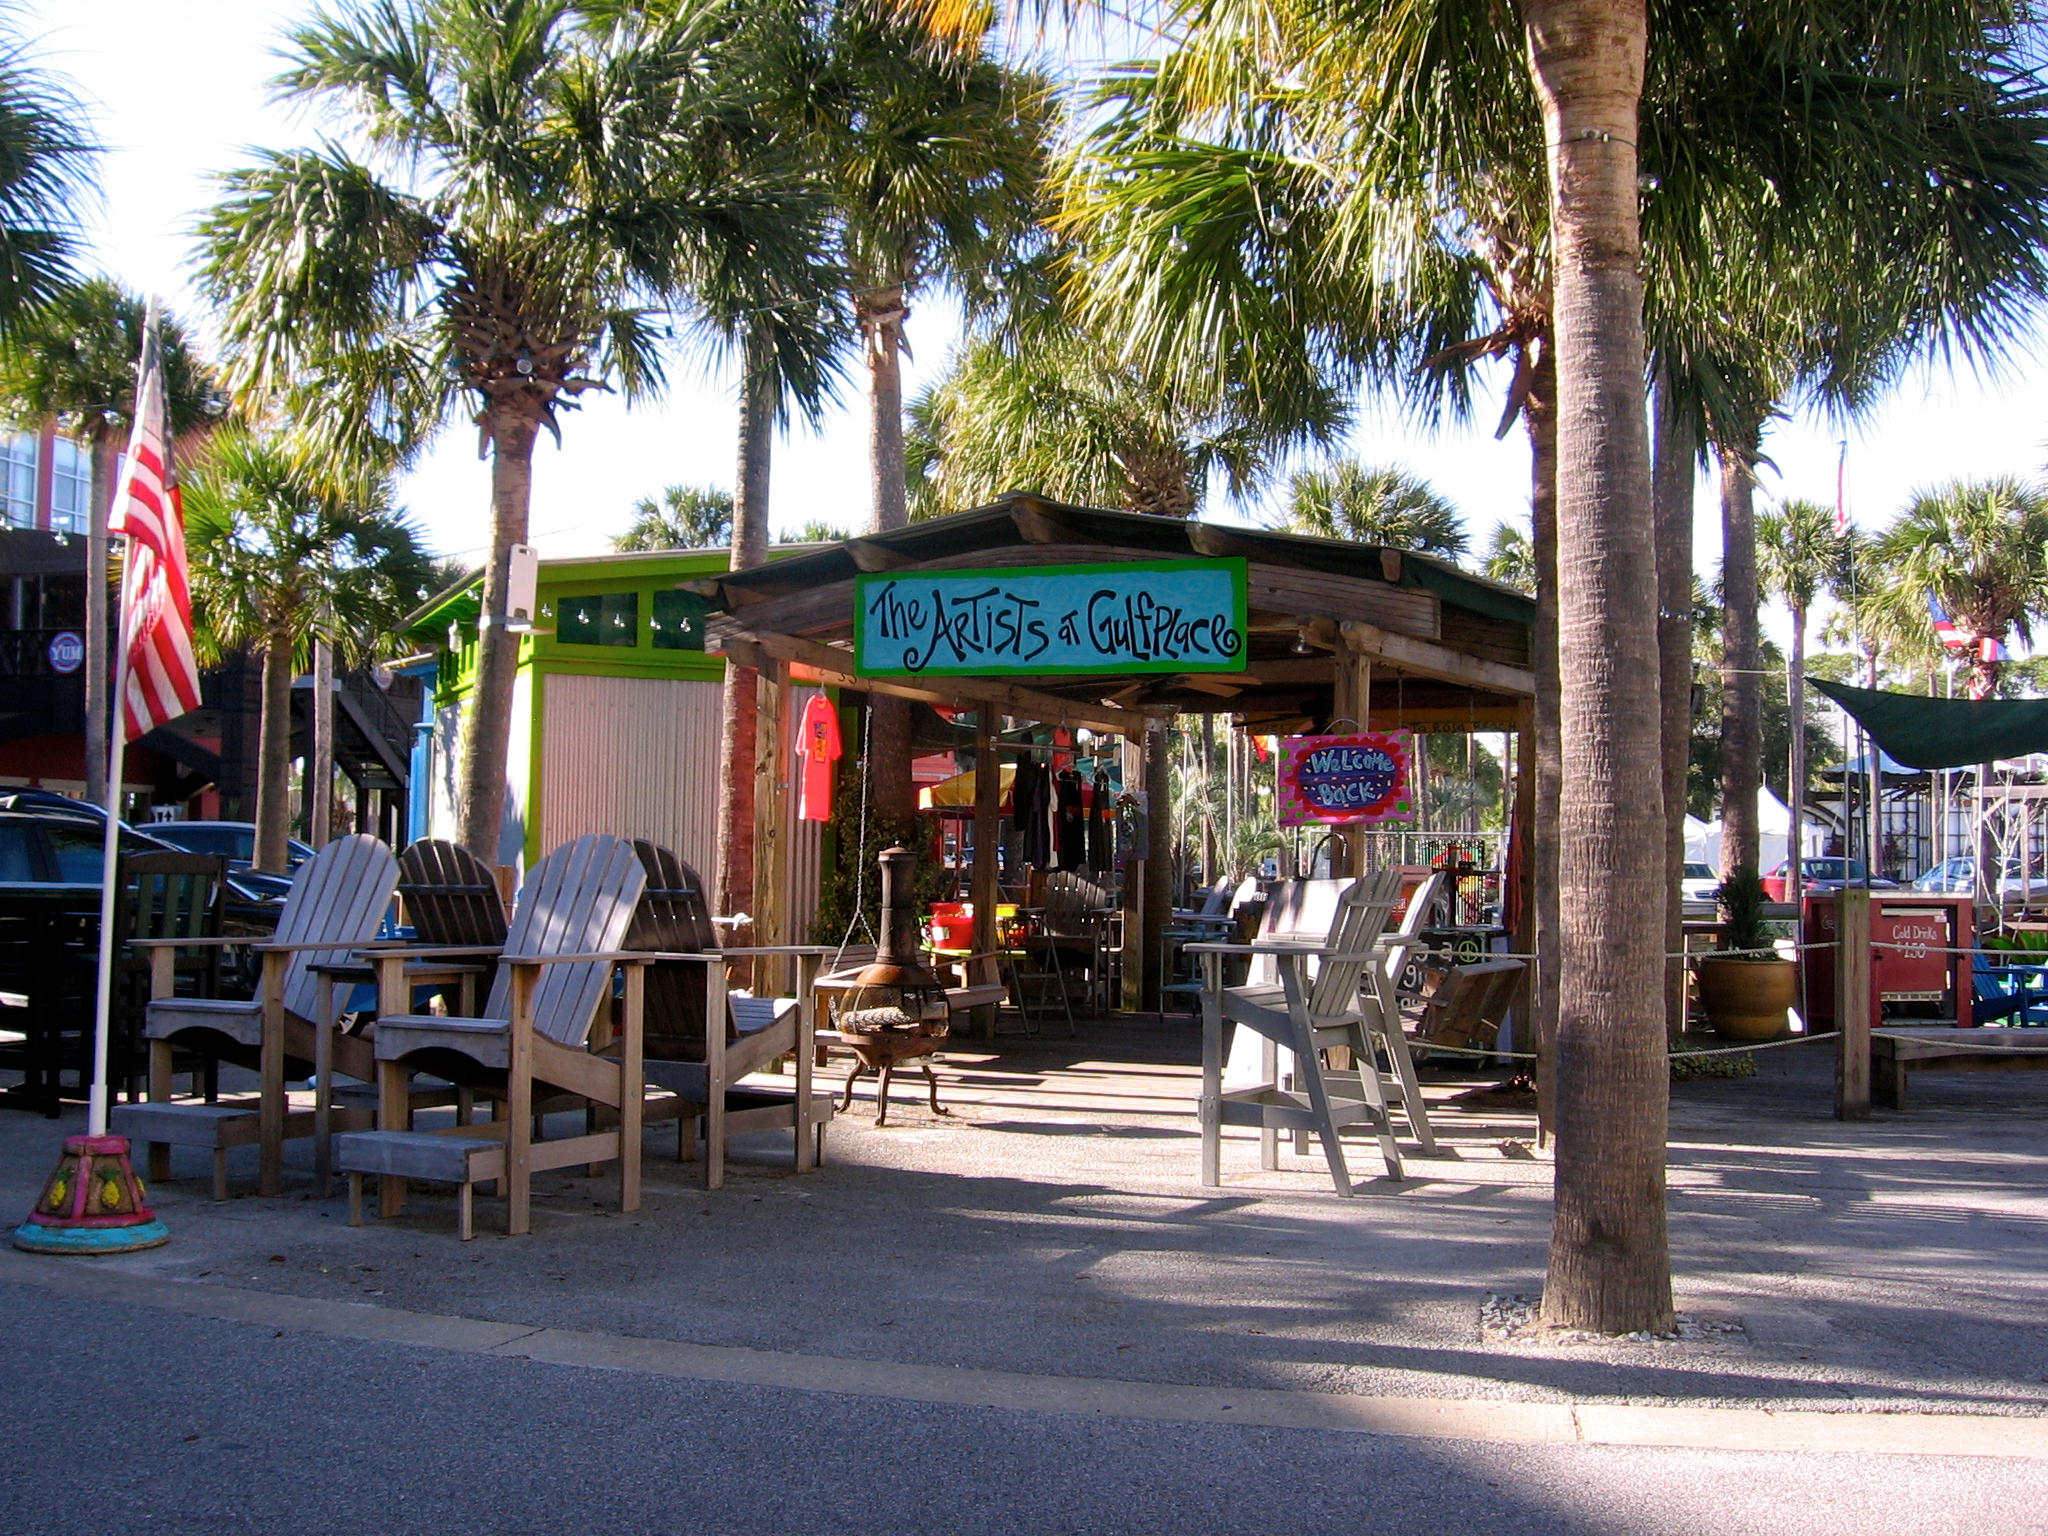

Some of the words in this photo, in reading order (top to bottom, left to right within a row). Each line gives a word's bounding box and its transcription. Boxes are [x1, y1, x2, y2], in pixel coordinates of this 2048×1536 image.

[869, 581, 928, 640] The
[51, 644, 83, 660] YUM
[1892, 924, 1911, 940] Cold
